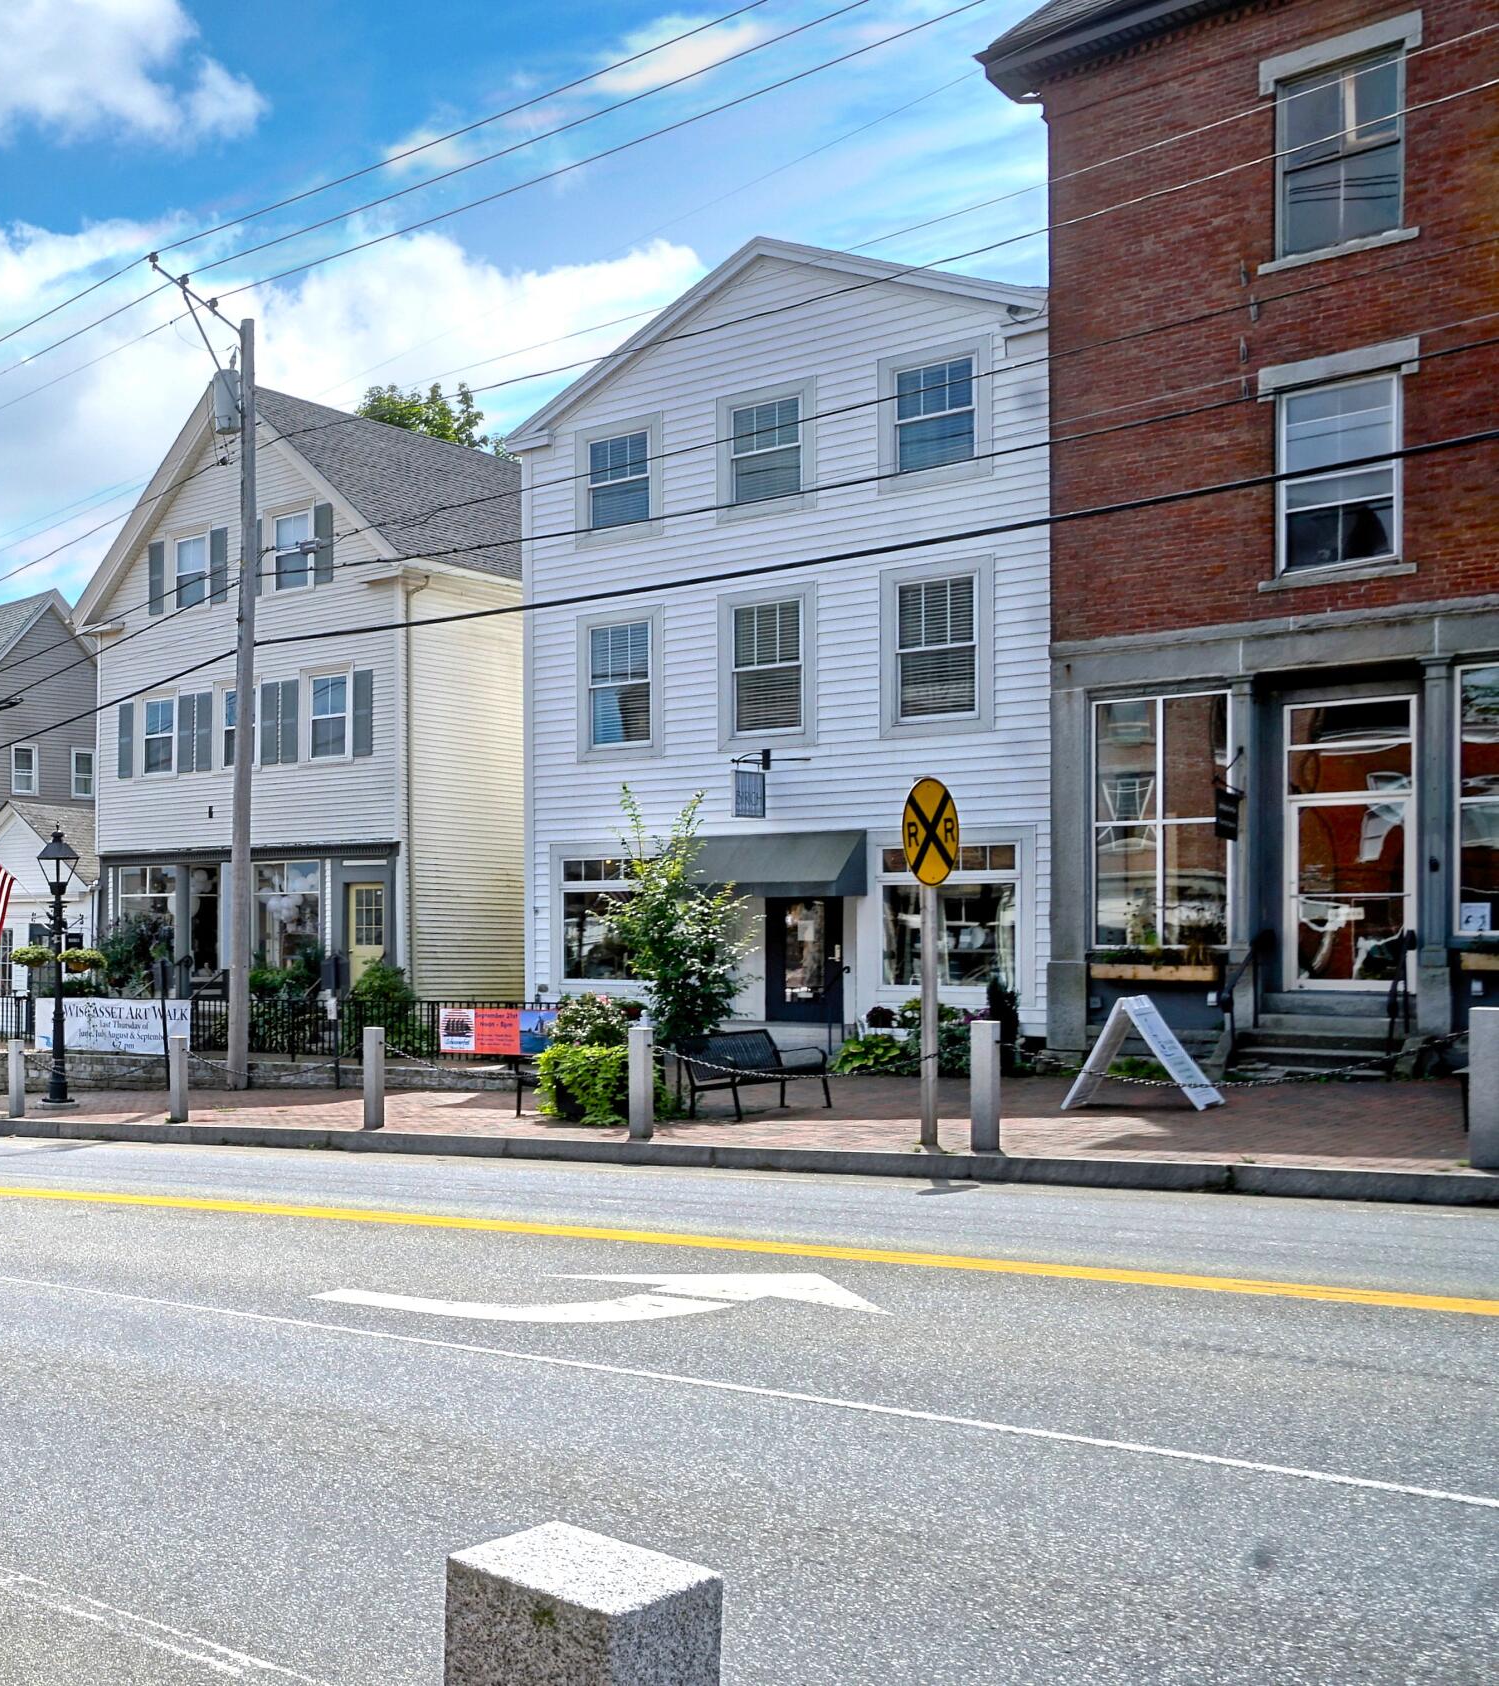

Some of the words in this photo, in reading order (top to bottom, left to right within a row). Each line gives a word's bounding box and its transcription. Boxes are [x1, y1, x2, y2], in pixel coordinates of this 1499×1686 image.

[907, 822, 919, 847] R
[944, 818, 956, 842] R
[64, 1003, 124, 1020] WISCASSET
[125, 1004, 150, 1020] ART
[152, 1005, 189, 1021] WALK
[113, 1020, 141, 1030] Thursday
[142, 1021, 149, 1029] of
[108, 1031, 128, 1040] August
